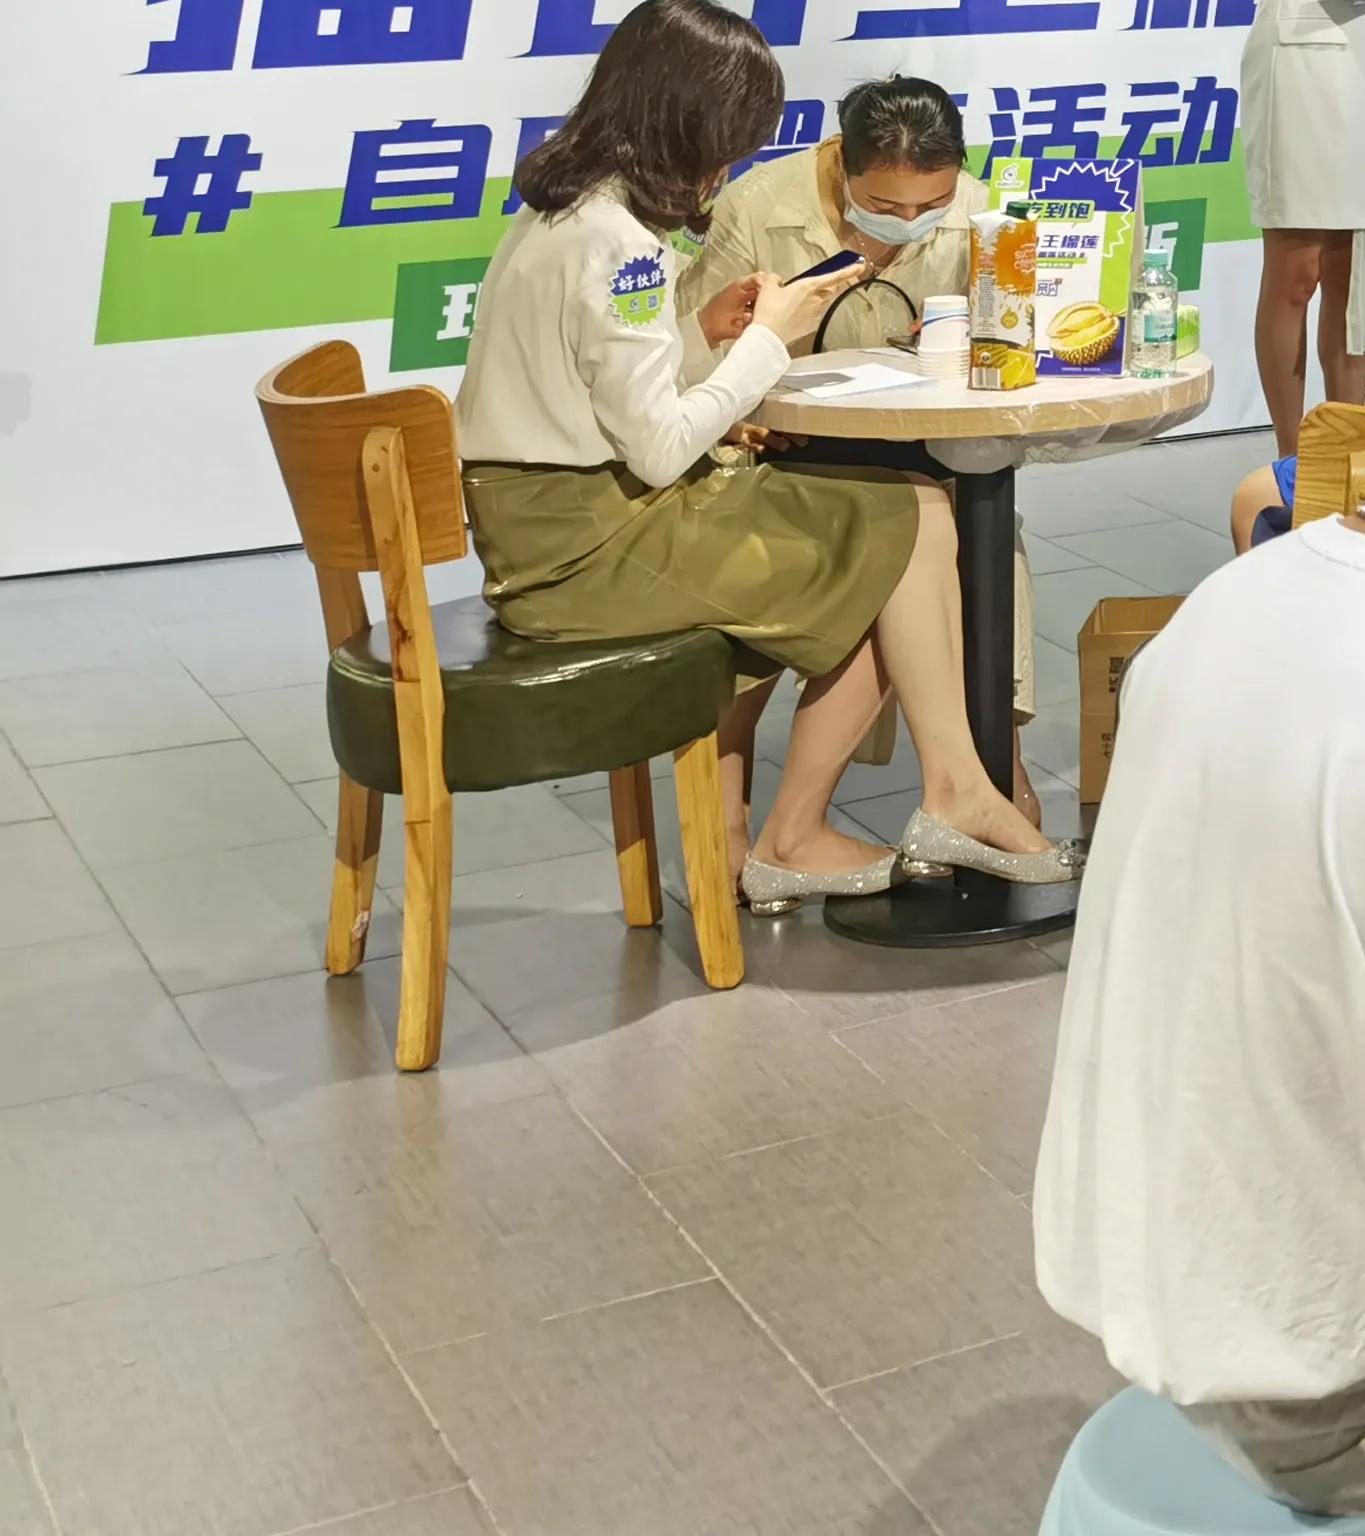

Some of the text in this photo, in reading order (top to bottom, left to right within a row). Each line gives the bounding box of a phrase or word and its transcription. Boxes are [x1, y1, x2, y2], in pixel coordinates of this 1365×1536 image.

[143, 133, 263, 238] #
[619, 270, 662, 292] 好伙伴
